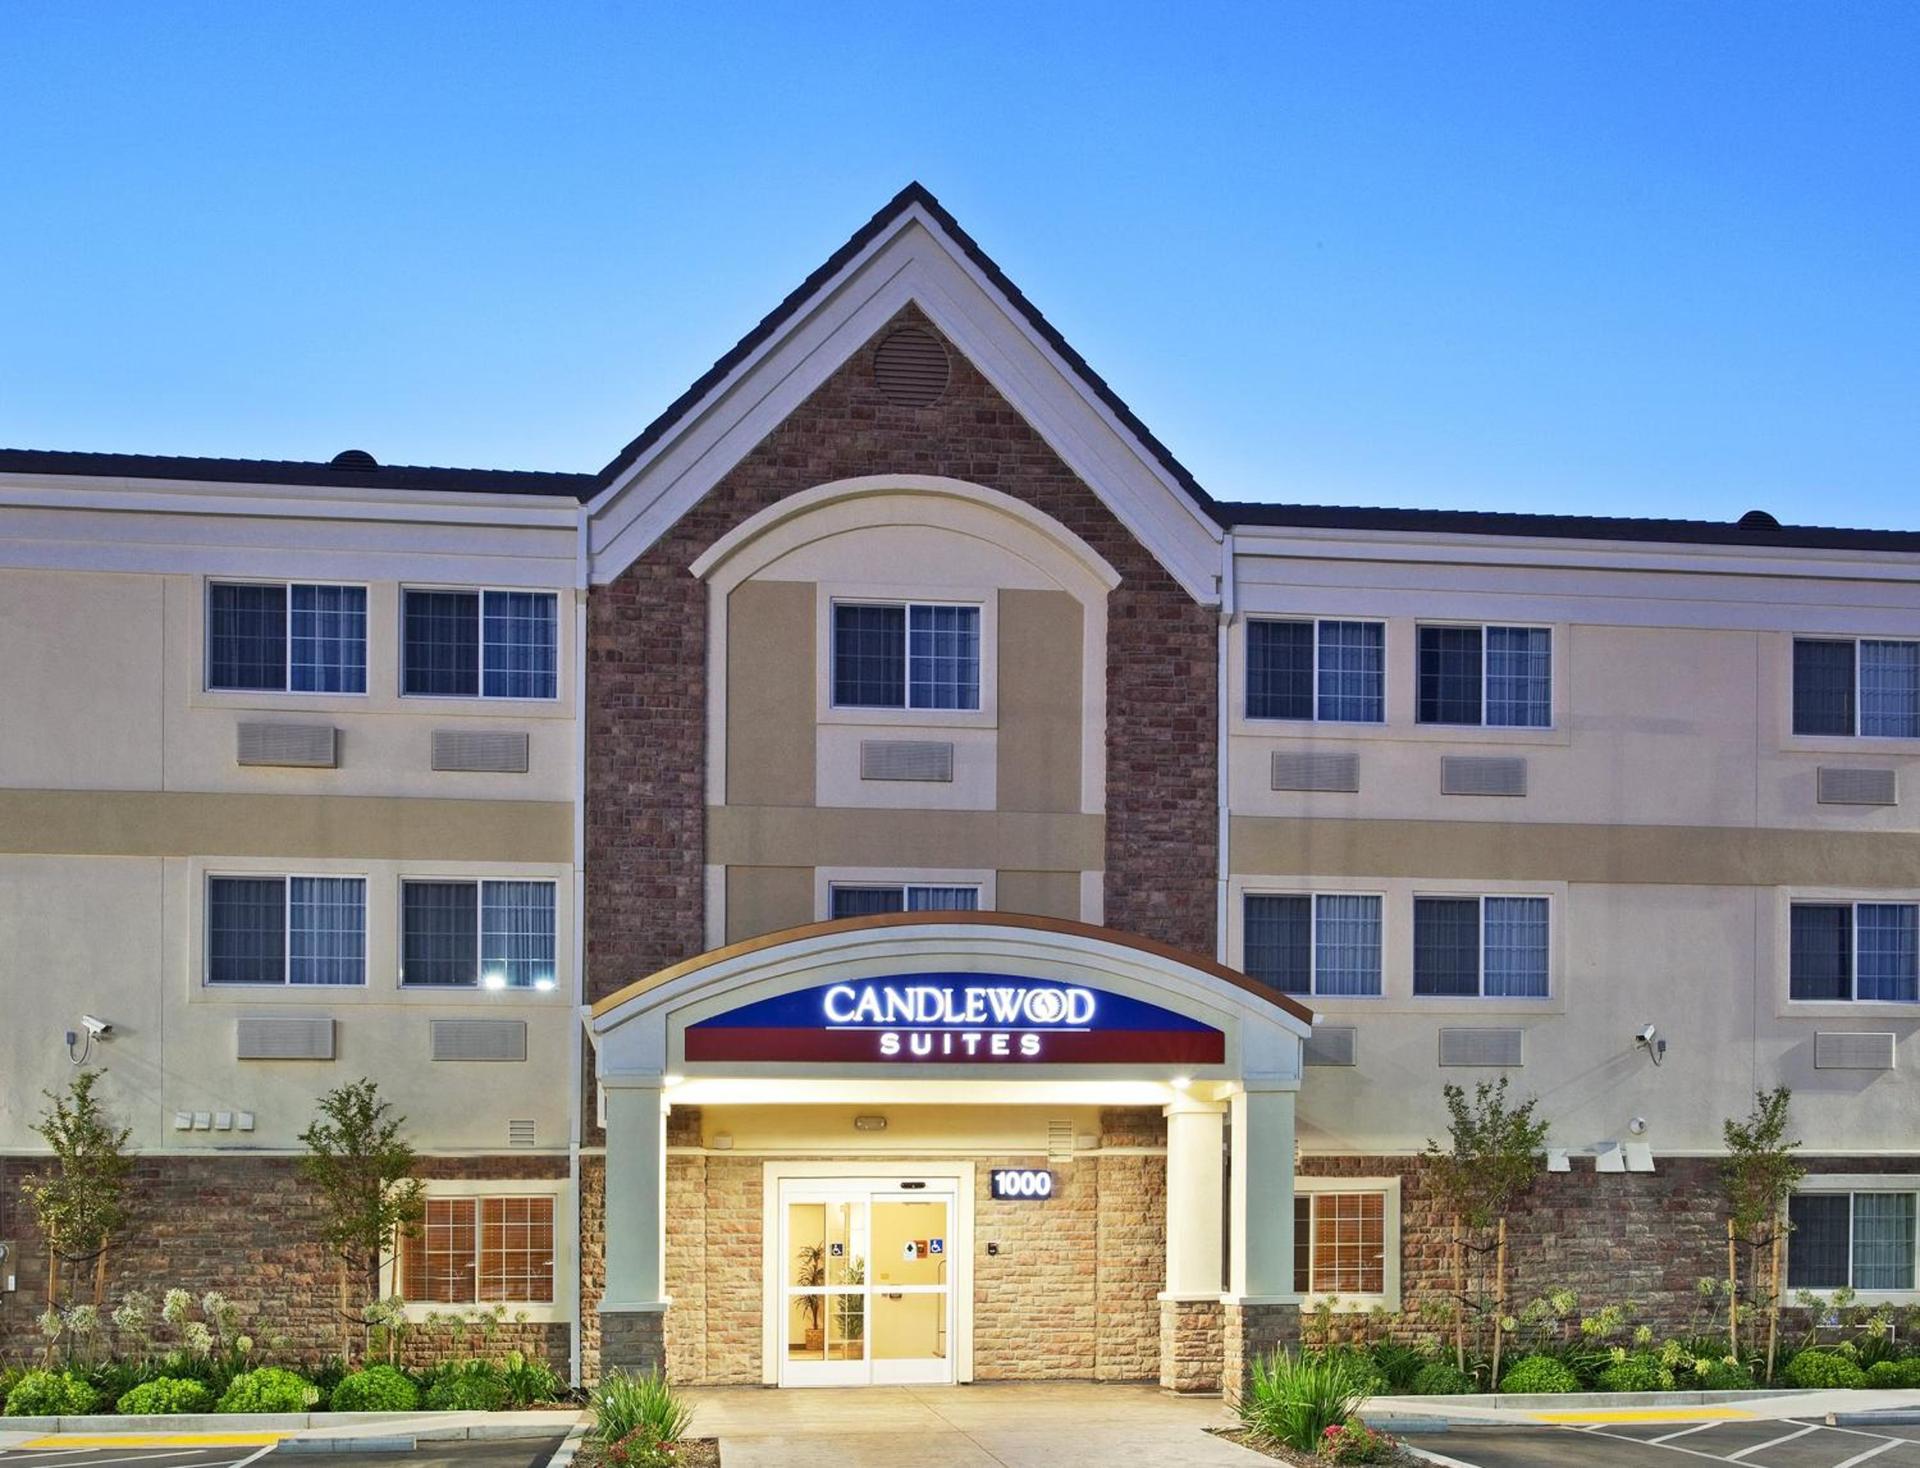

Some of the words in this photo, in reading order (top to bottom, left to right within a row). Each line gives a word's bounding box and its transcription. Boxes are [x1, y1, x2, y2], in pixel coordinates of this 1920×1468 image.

[824, 986, 1096, 1024] CANDLEWOOD
[880, 1033, 1041, 1056] SUITES
[995, 1171, 1052, 1196] 1000
